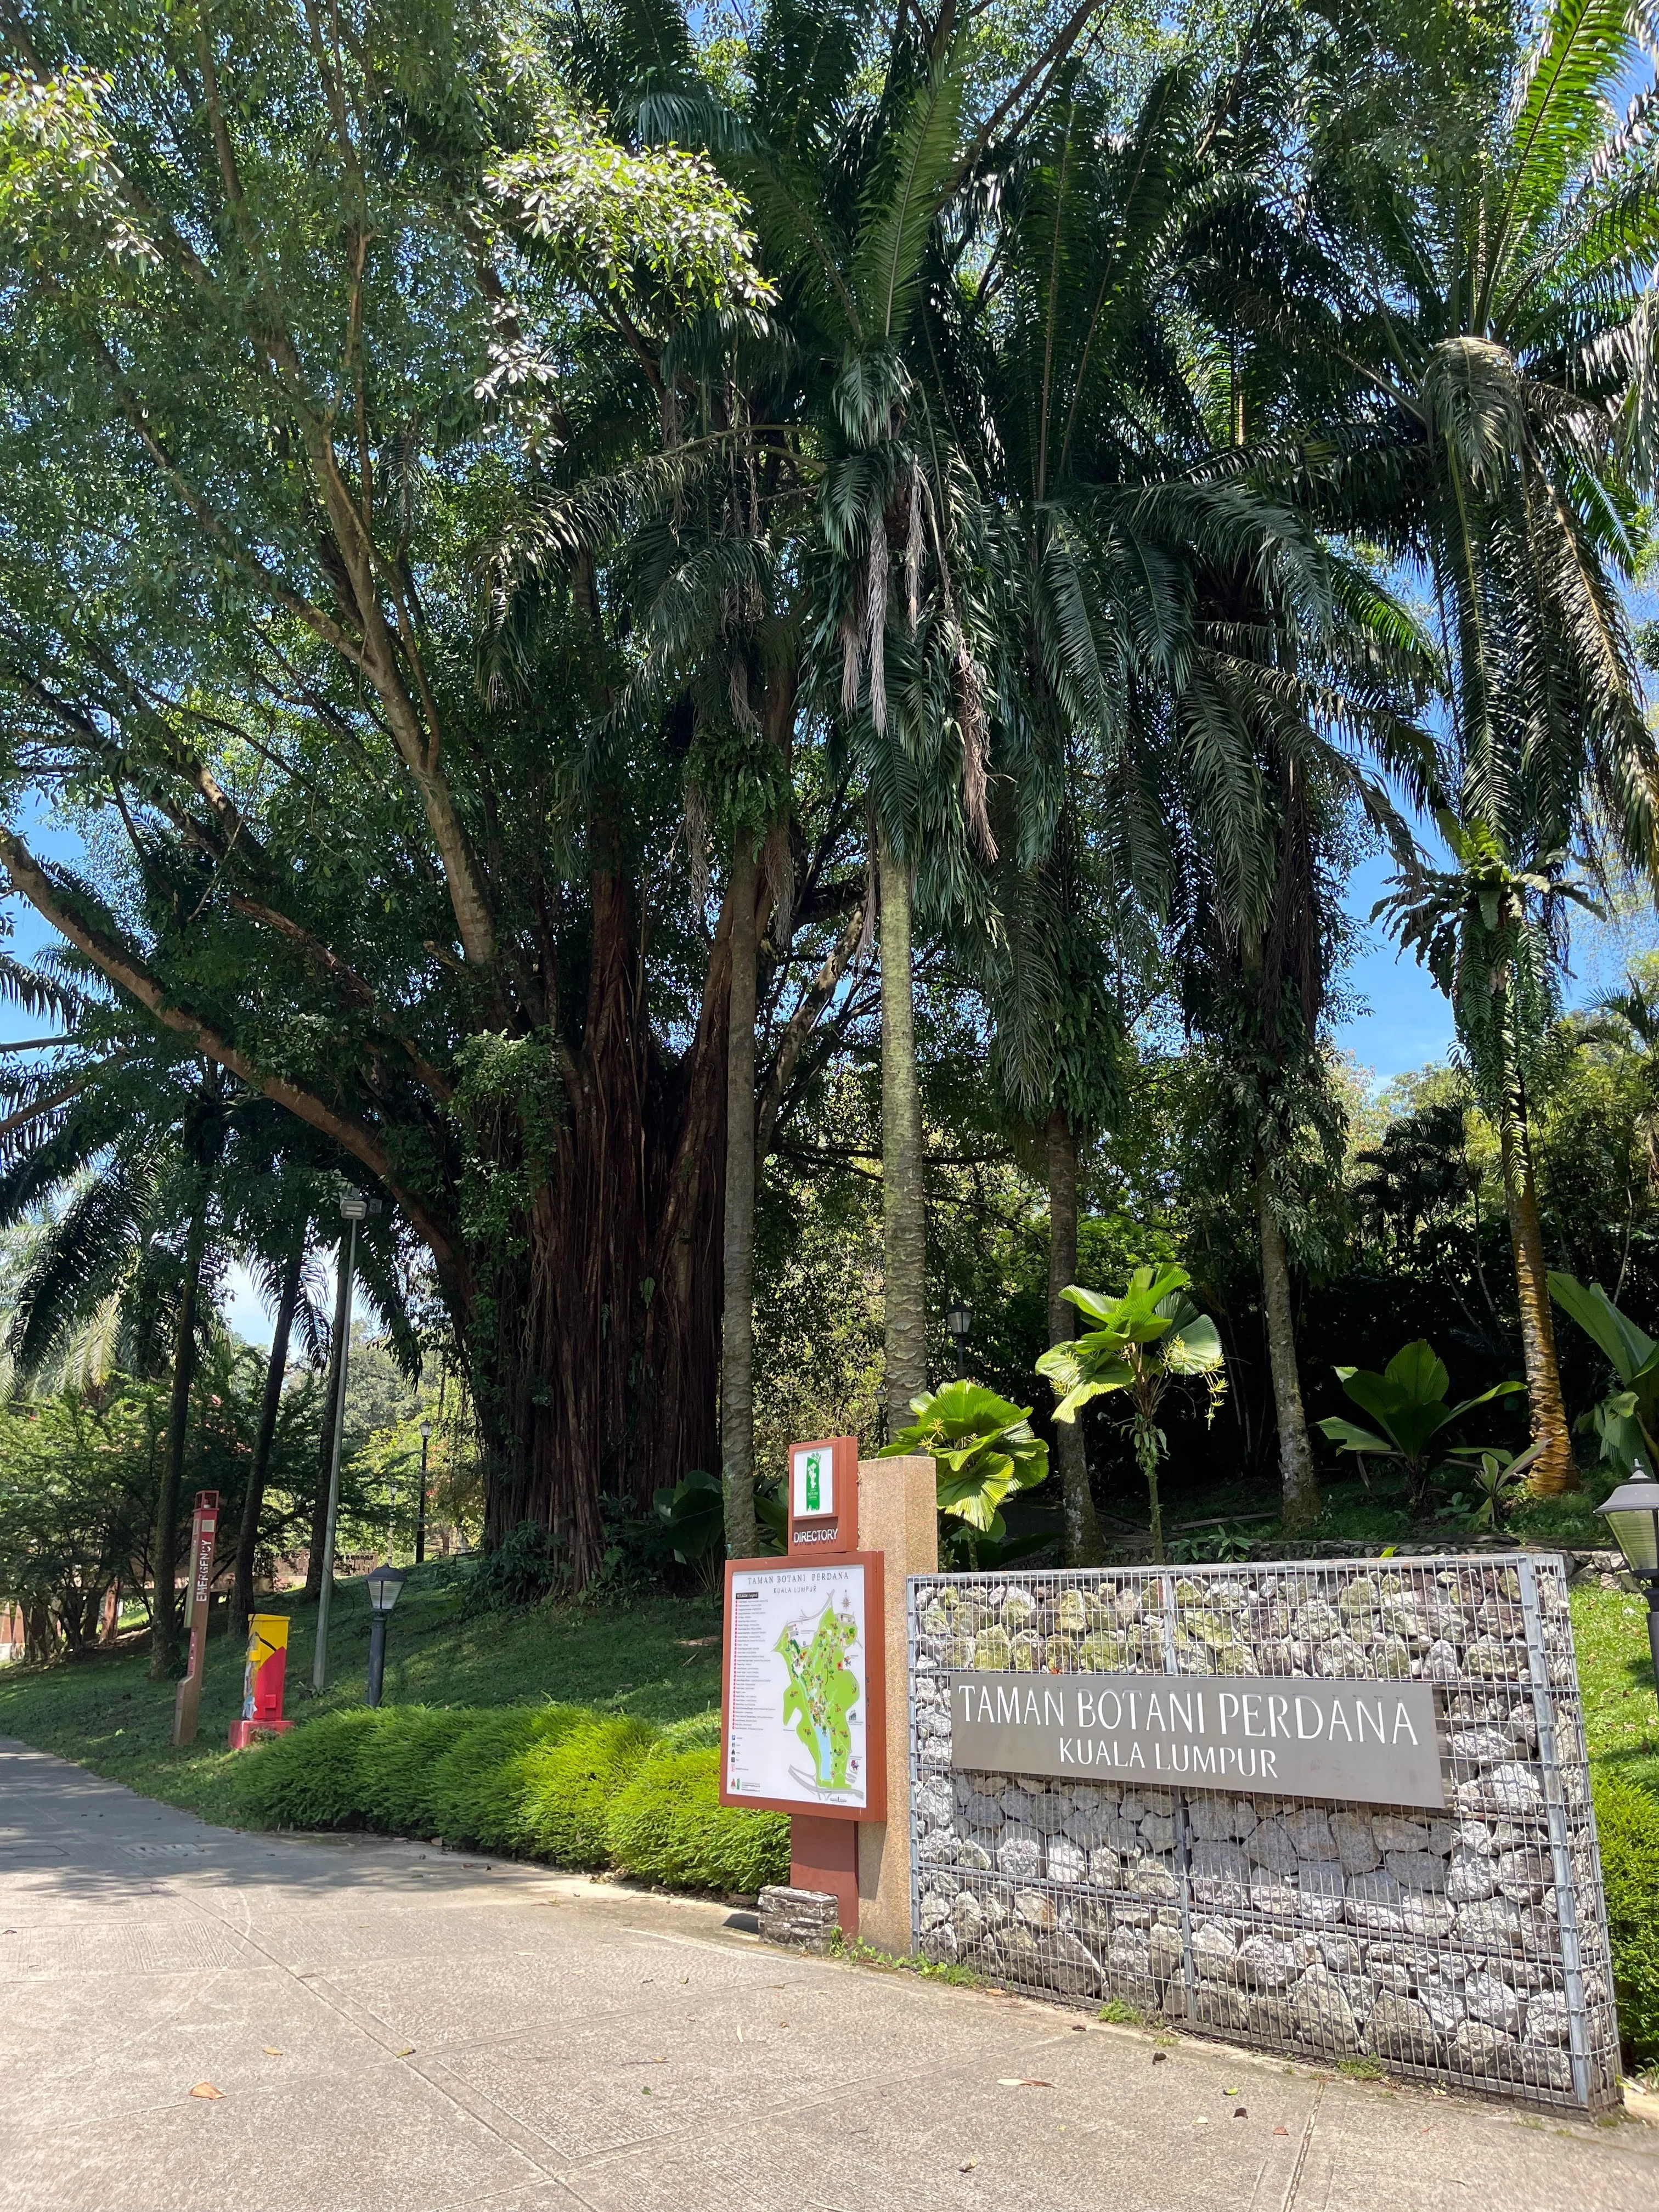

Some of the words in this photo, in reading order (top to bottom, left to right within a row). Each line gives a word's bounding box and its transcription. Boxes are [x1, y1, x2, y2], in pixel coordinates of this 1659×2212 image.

[794, 1528, 838, 1543] DIRECTORY
[196, 1539, 212, 1602] EMERGENCY
[748, 1576, 774, 1584] TAMAN
[777, 1574, 805, 1583] BOTANI
[812, 1572, 848, 1581] PERDANA
[959, 1685, 1064, 1726] TAMAN
[1077, 1688, 1205, 1734] BOTANI
[1218, 1691, 1420, 1745] PERDANA
[1060, 1737, 1145, 1768] KUALA
[1155, 1742, 1278, 1778] LUMPUR
